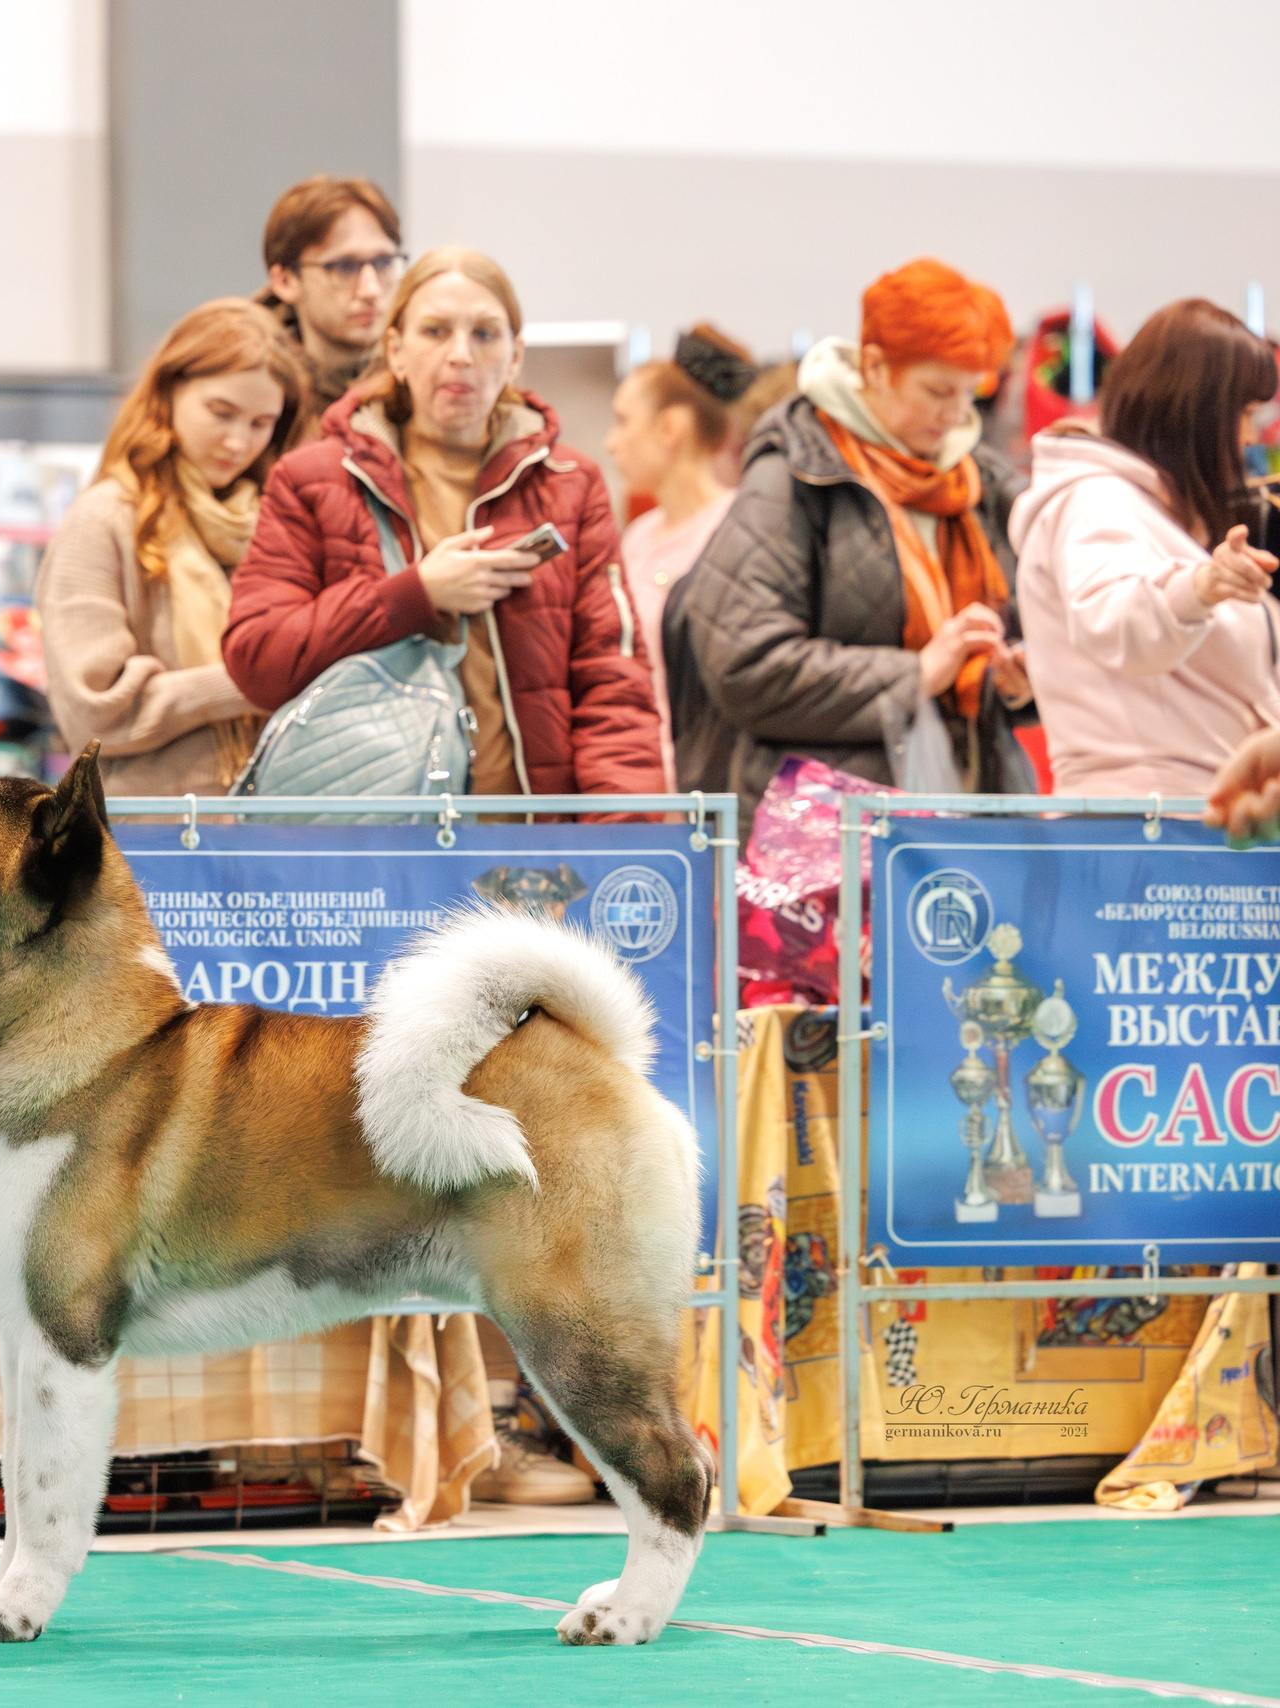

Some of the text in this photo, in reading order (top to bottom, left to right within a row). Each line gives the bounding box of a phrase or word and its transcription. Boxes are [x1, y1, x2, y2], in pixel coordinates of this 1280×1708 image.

[145, 891, 224, 909] ЕННЫХ
[1144, 884, 1280, 903] СОЮЗ ОБЩЕСТ
[161, 929, 363, 947] INOLOGICAL UNION
[173, 960, 370, 1012] АРОДН
[1092, 1062, 1280, 1148] CAC
